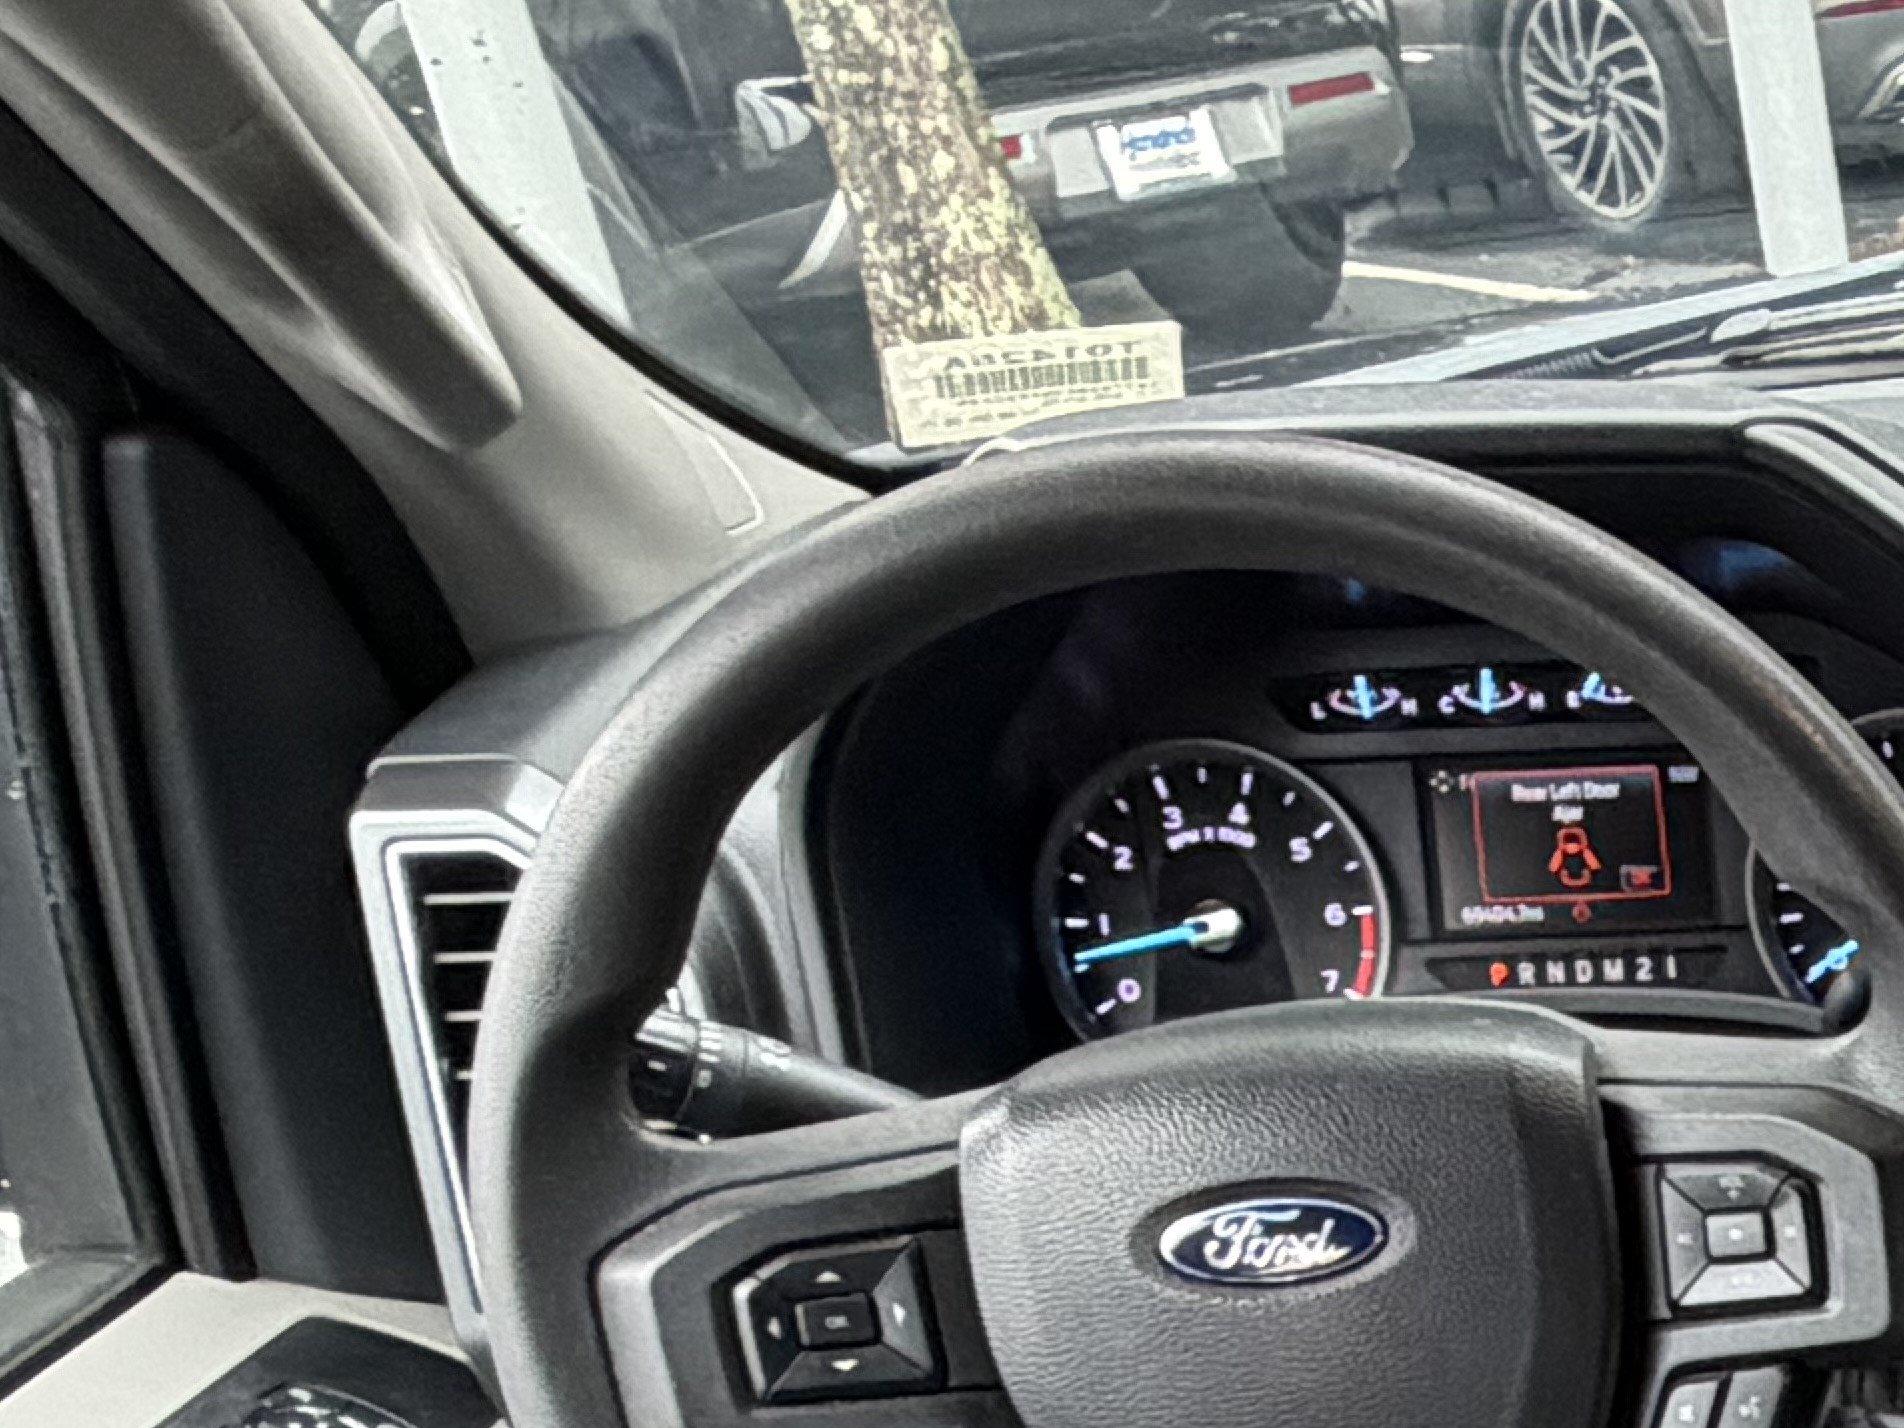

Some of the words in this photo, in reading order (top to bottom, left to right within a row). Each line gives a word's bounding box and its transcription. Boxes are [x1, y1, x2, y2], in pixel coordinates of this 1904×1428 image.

[1439, 695, 1456, 714] C
[1162, 805, 1184, 830] 3
[1228, 801, 1251, 826] 4
[1113, 845, 1134, 871] 2
[1288, 836, 1312, 862] 5
[1099, 912, 1110, 937] 1
[1323, 902, 1348, 927] 6
[1320, 968, 1340, 993] 7
[1488, 960, 1511, 987] P
[1516, 961, 1536, 987] R
[1546, 960, 1566, 984] N
[1574, 958, 1594, 984] D
[1602, 956, 1625, 982] M
[1634, 956, 1654, 982] 2
[1116, 977, 1142, 1003] 0
[1203, 1208, 1353, 1271] Ford
